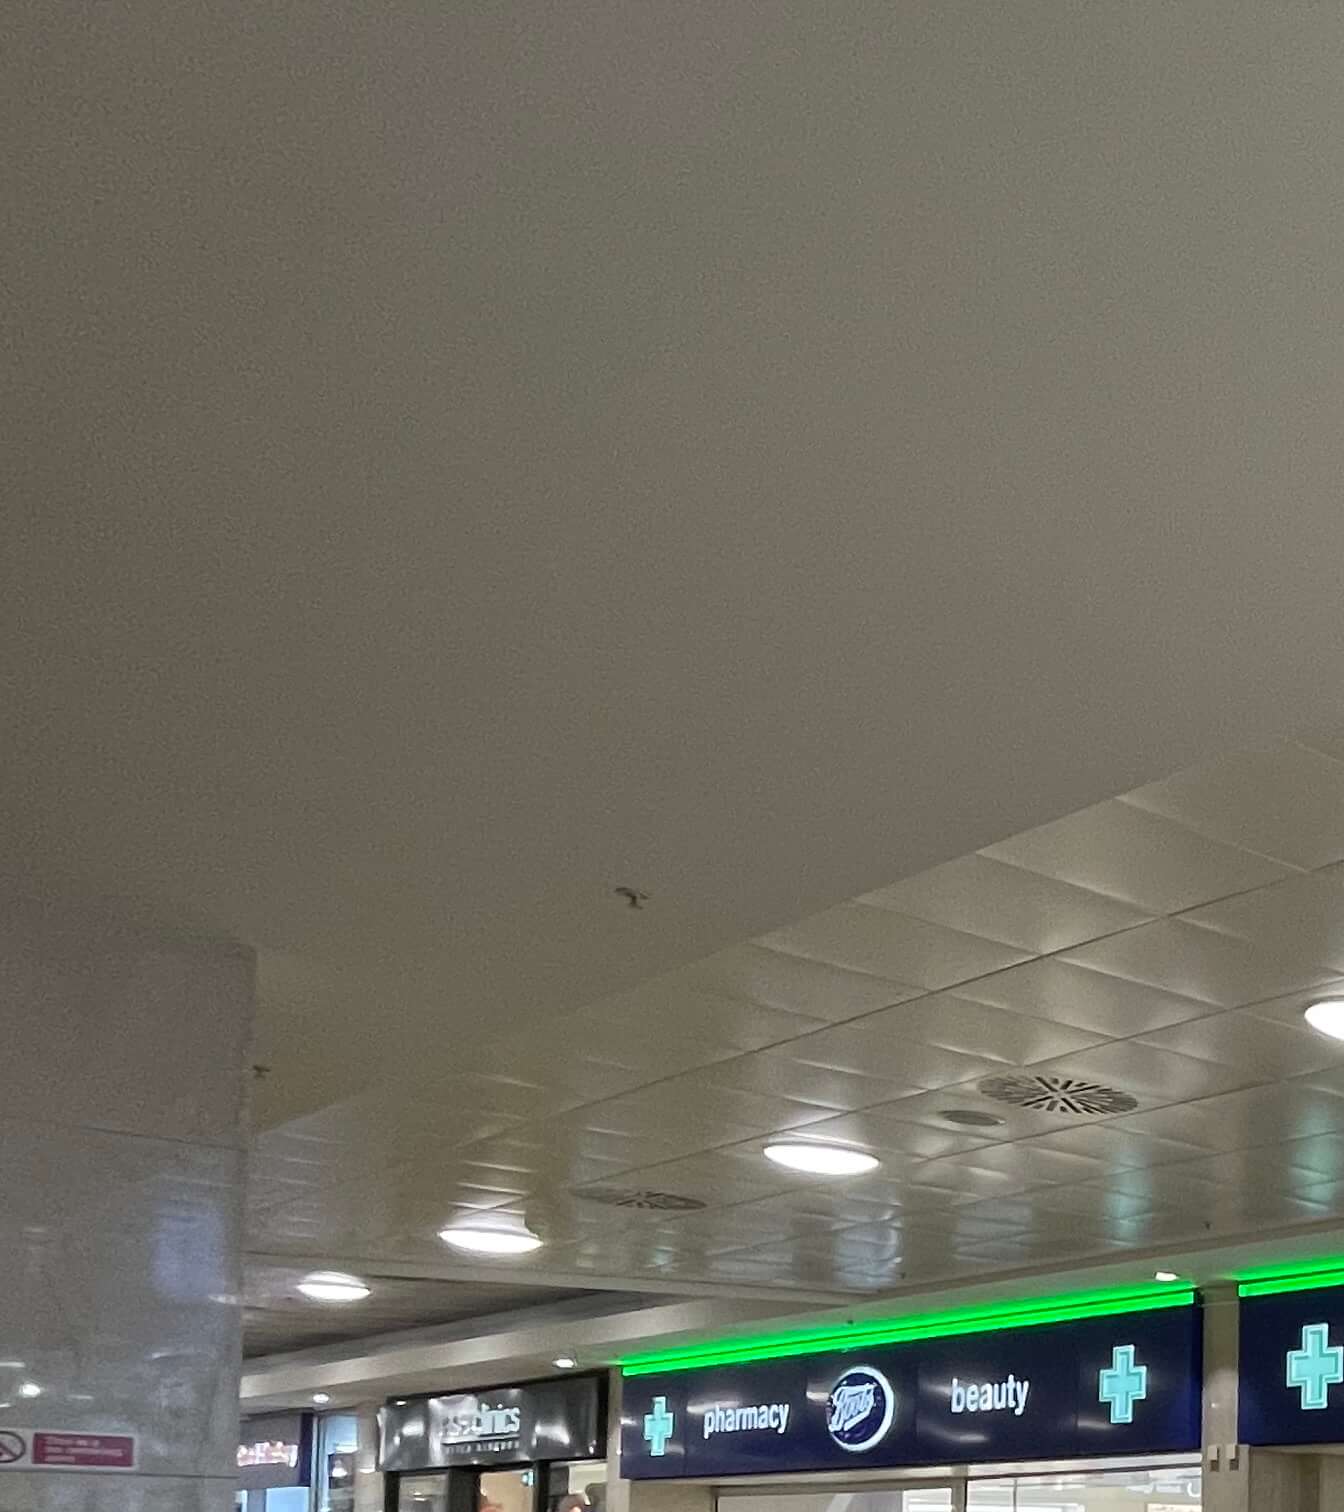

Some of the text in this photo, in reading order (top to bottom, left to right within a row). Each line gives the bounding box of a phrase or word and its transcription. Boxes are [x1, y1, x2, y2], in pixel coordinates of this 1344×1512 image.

[828, 1383, 877, 1432] Boots
[951, 1374, 1028, 1415] beauty
[703, 1403, 790, 1439] pharmacy
